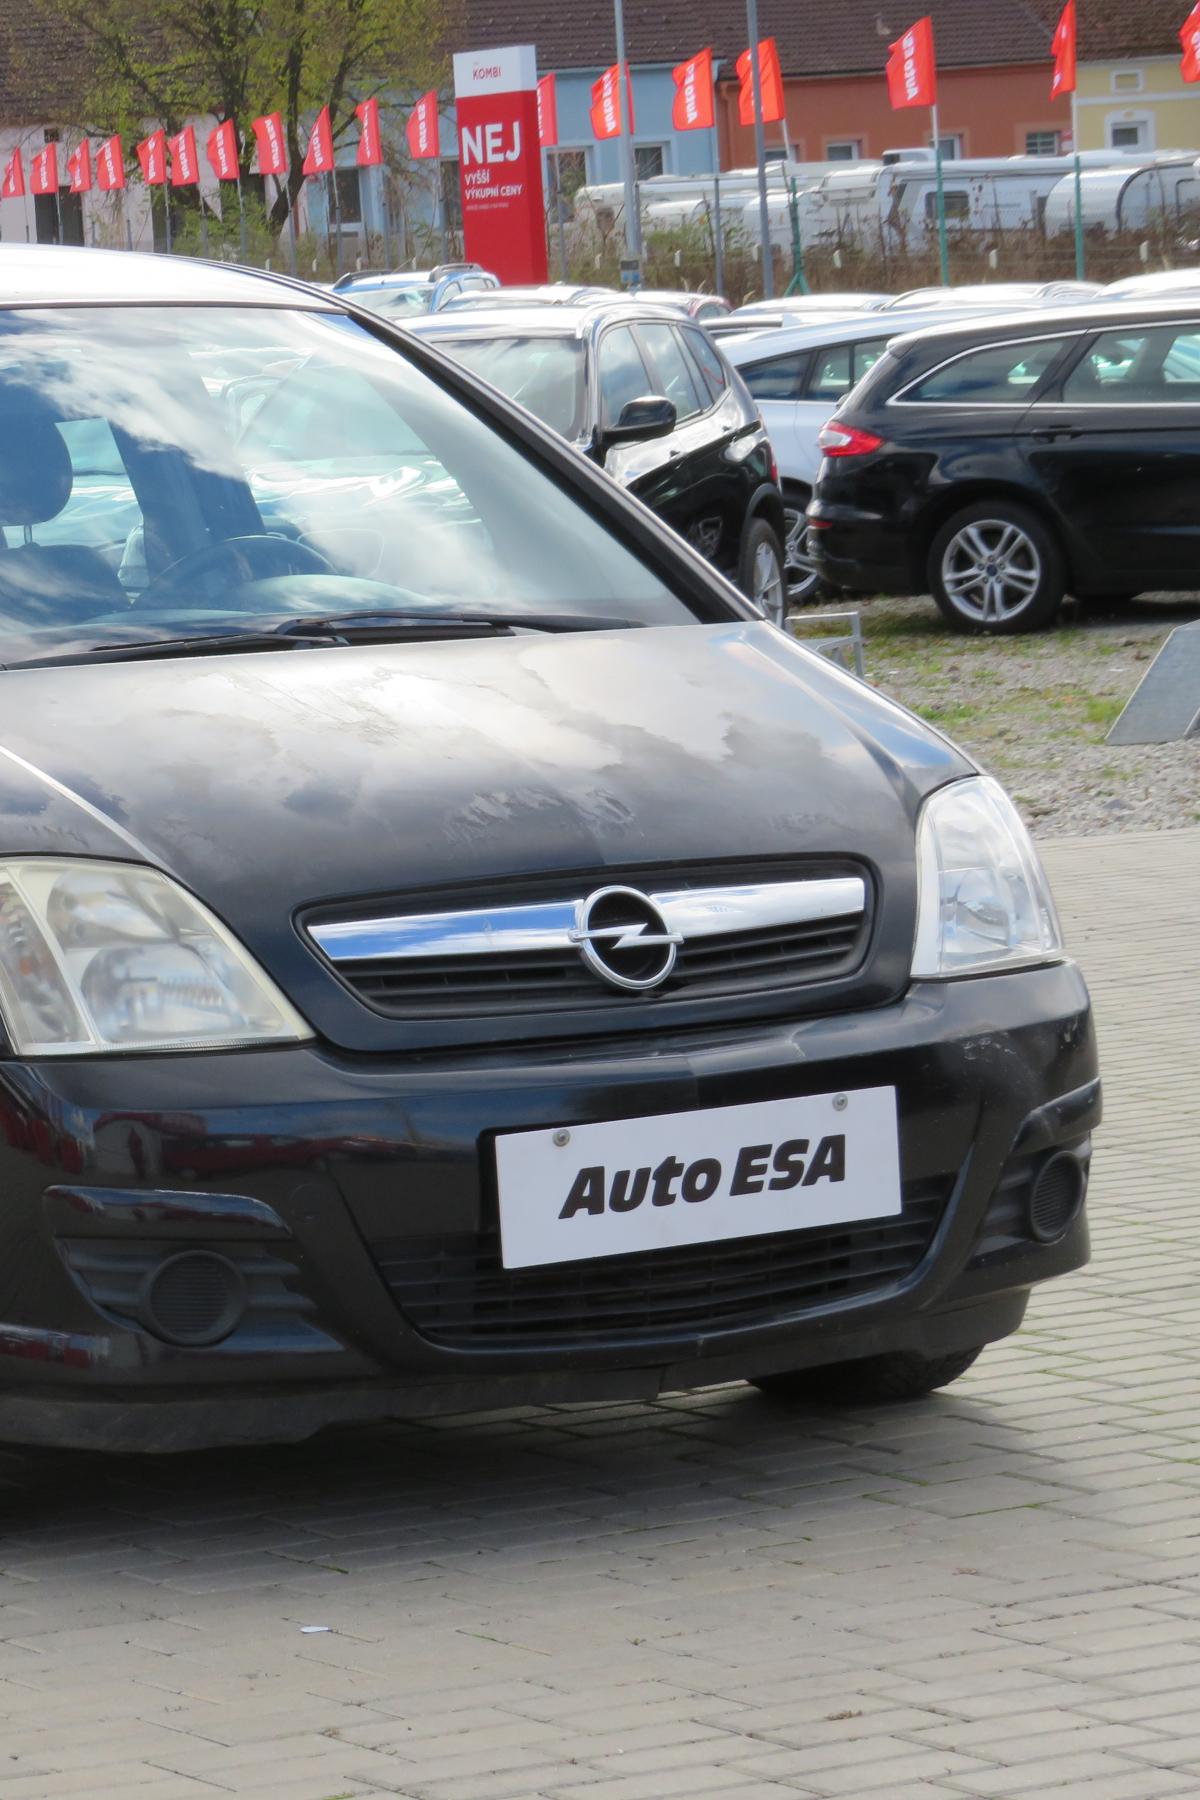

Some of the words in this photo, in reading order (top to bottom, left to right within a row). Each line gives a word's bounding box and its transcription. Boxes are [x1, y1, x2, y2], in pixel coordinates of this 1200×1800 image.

[472, 67, 502, 80] KOMBI
[461, 120, 521, 166] NEJ
[464, 168, 490, 186] VYŠŠÍ
[500, 184, 522, 197] CENY
[557, 1155, 722, 1220] Auto
[729, 1133, 846, 1197] ESA
